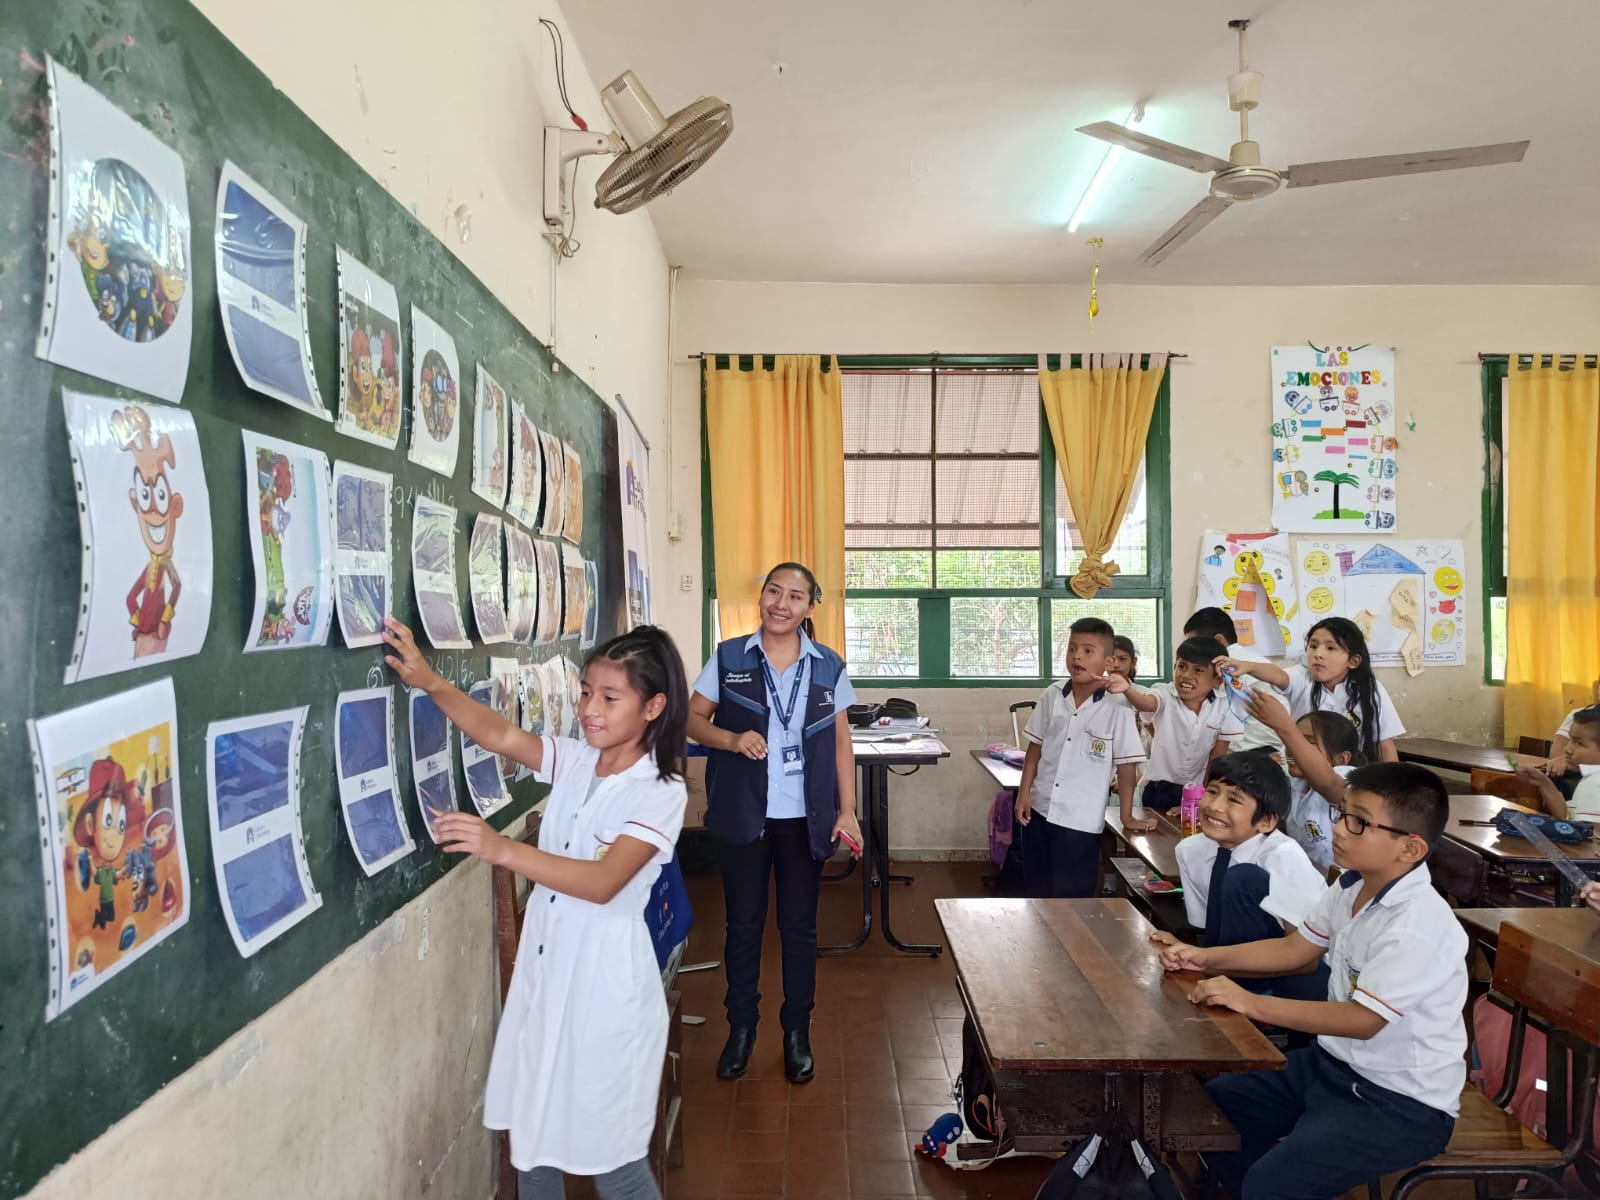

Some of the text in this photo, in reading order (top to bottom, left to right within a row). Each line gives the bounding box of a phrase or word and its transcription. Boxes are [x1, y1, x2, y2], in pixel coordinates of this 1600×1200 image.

[1315, 351, 1349, 367] LAS
[1286, 370, 1381, 386] EMOCIONES
[1375, 548, 1391, 557] Las
